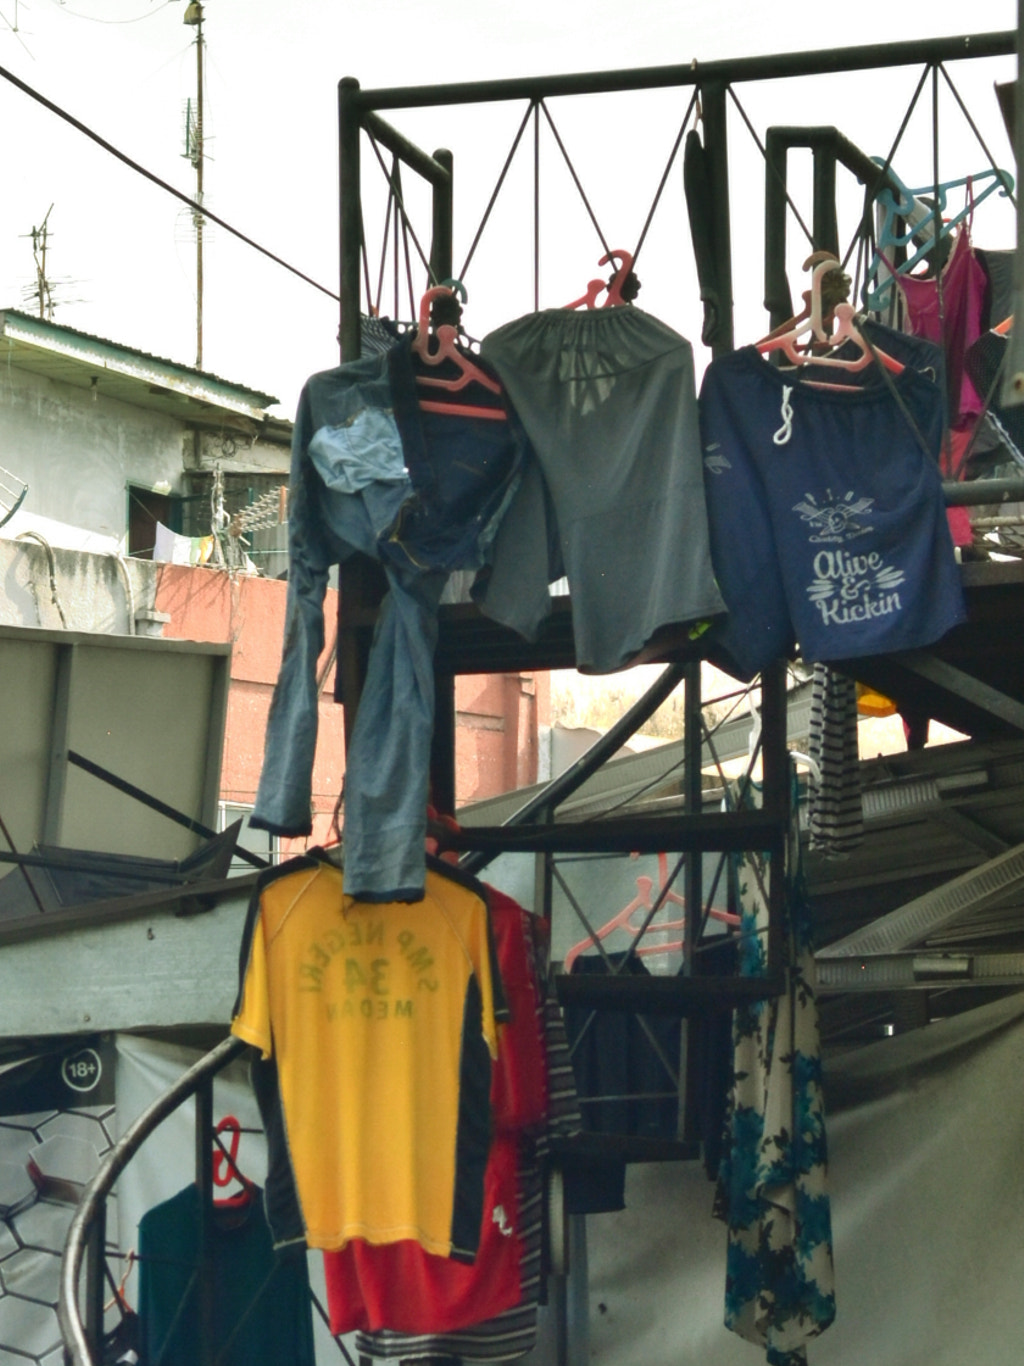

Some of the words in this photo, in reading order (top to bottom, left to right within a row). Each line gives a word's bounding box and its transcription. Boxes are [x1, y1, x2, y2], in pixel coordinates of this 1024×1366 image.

[814, 550, 883, 579] Alive
[840, 576, 871, 600] &
[816, 592, 902, 626] Kickin
[68, 1057, 97, 1078] 18+
